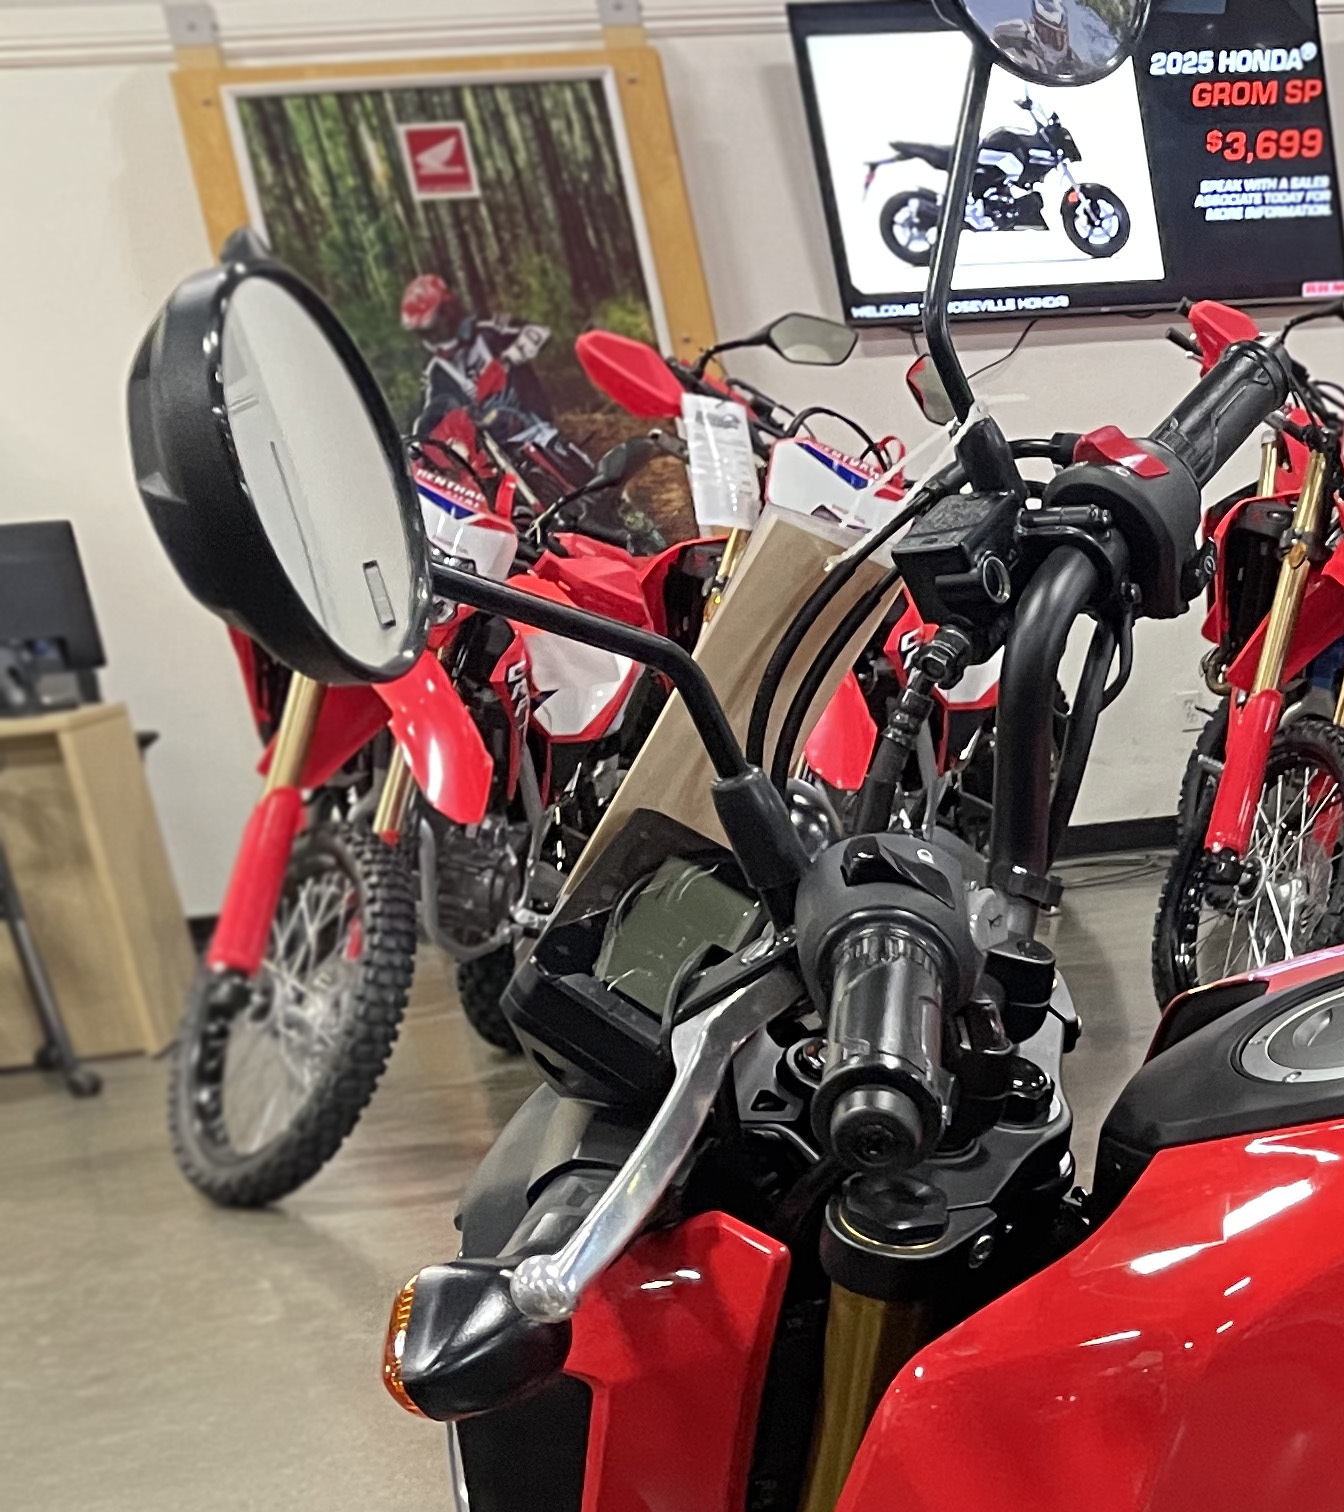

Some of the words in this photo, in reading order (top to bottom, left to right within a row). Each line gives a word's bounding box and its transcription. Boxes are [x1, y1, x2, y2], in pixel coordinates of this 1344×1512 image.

[1150, 50, 1214, 75] 2025
[1191, 80, 1279, 107] GROM
[1284, 79, 1322, 104] SP
[1206, 128, 1323, 163] $3,699
